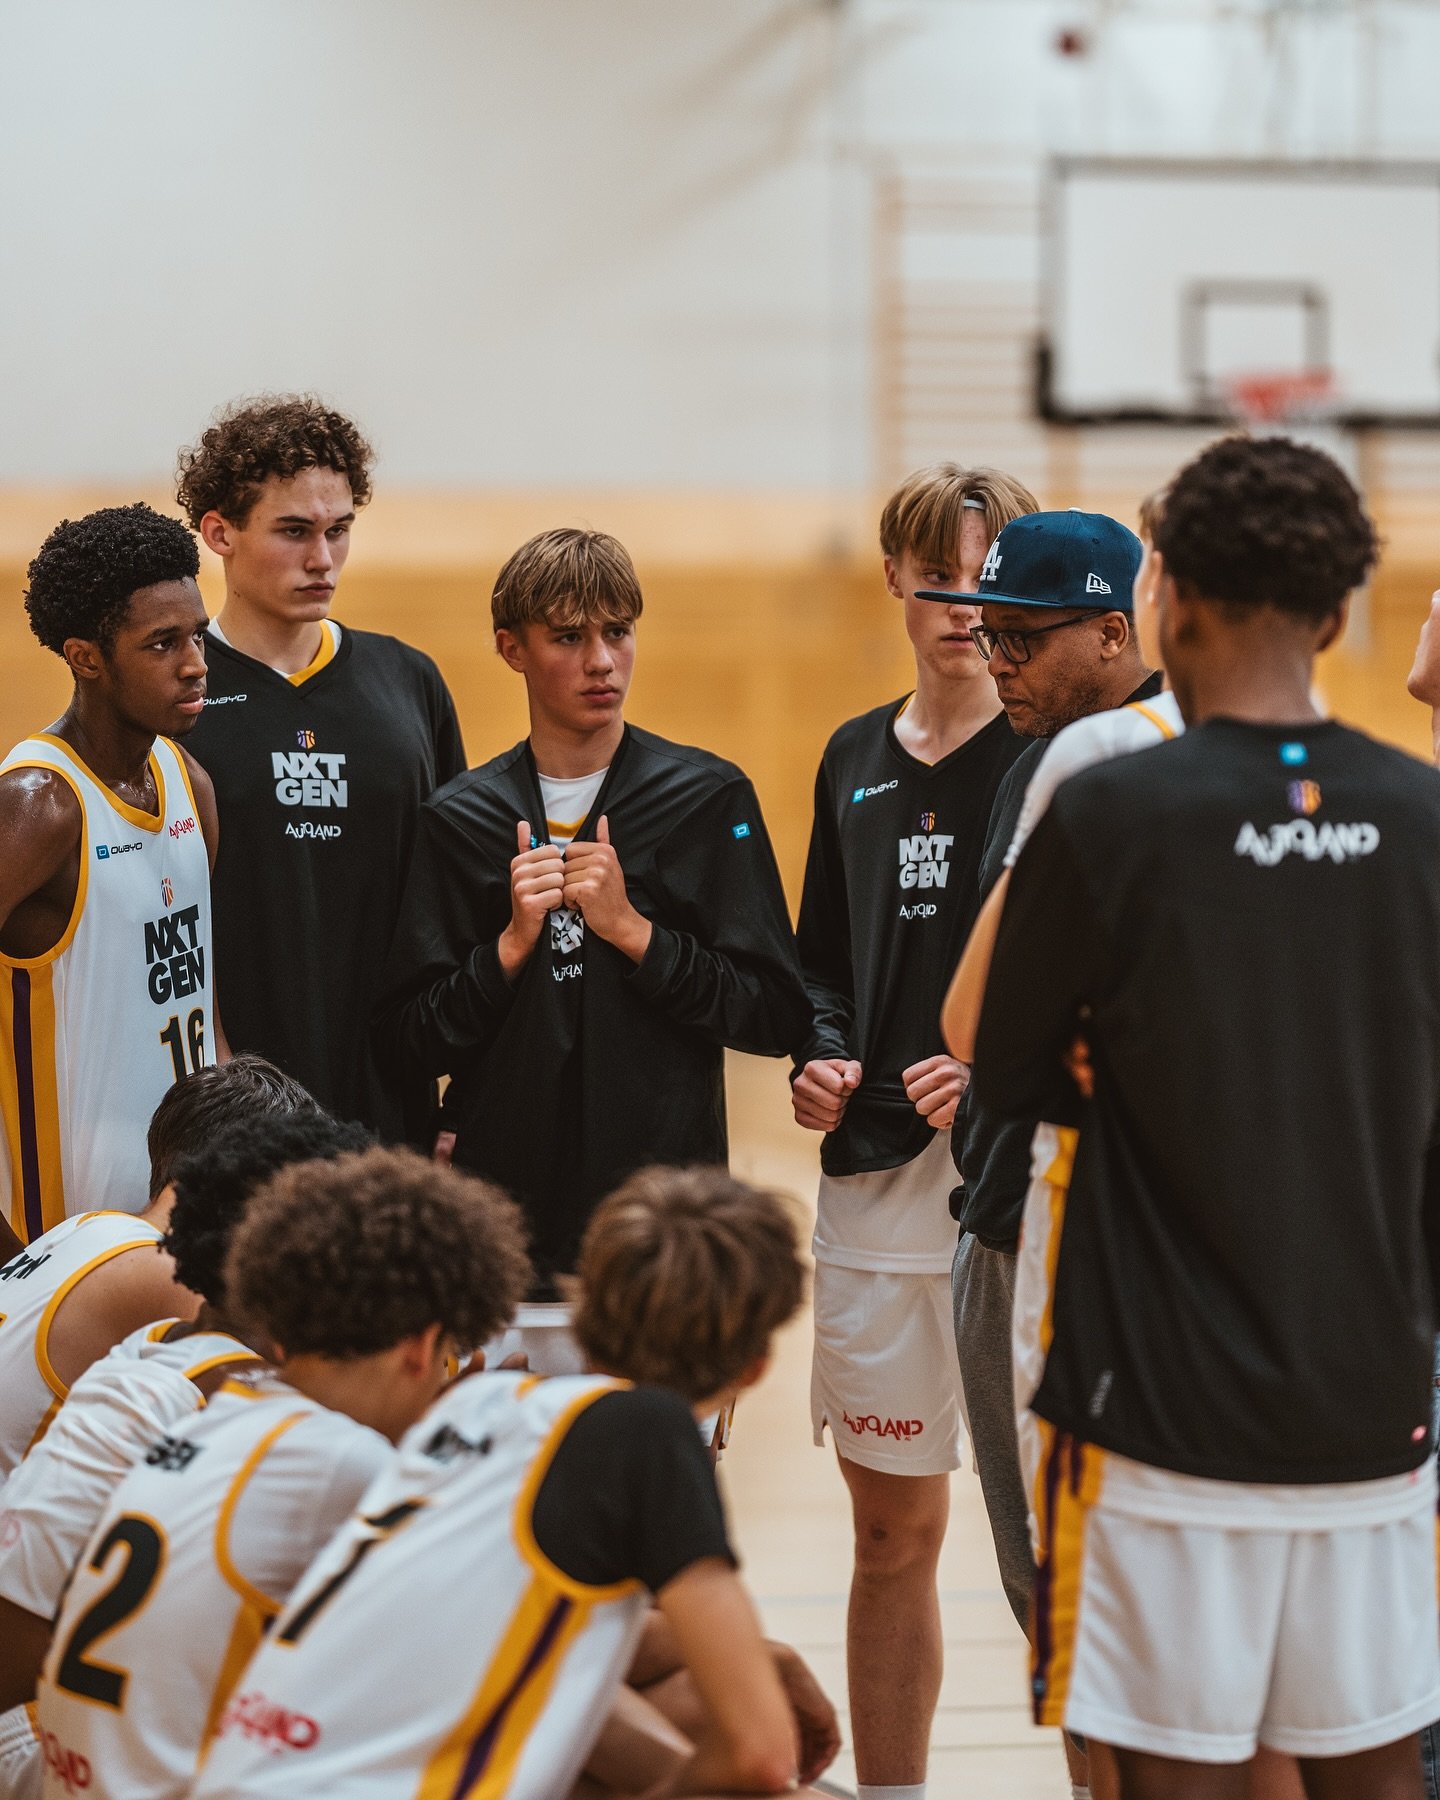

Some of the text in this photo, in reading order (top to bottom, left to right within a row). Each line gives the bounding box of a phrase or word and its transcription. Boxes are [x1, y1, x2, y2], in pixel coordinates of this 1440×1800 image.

[271, 751, 347, 780] NXT
[275, 778, 348, 808] GEN
[899, 834, 955, 865] NXT
[899, 861, 950, 889] GEN
[144, 904, 200, 965] NXT
[148, 946, 205, 1005] GEN
[53, 1509, 169, 1716] 2
